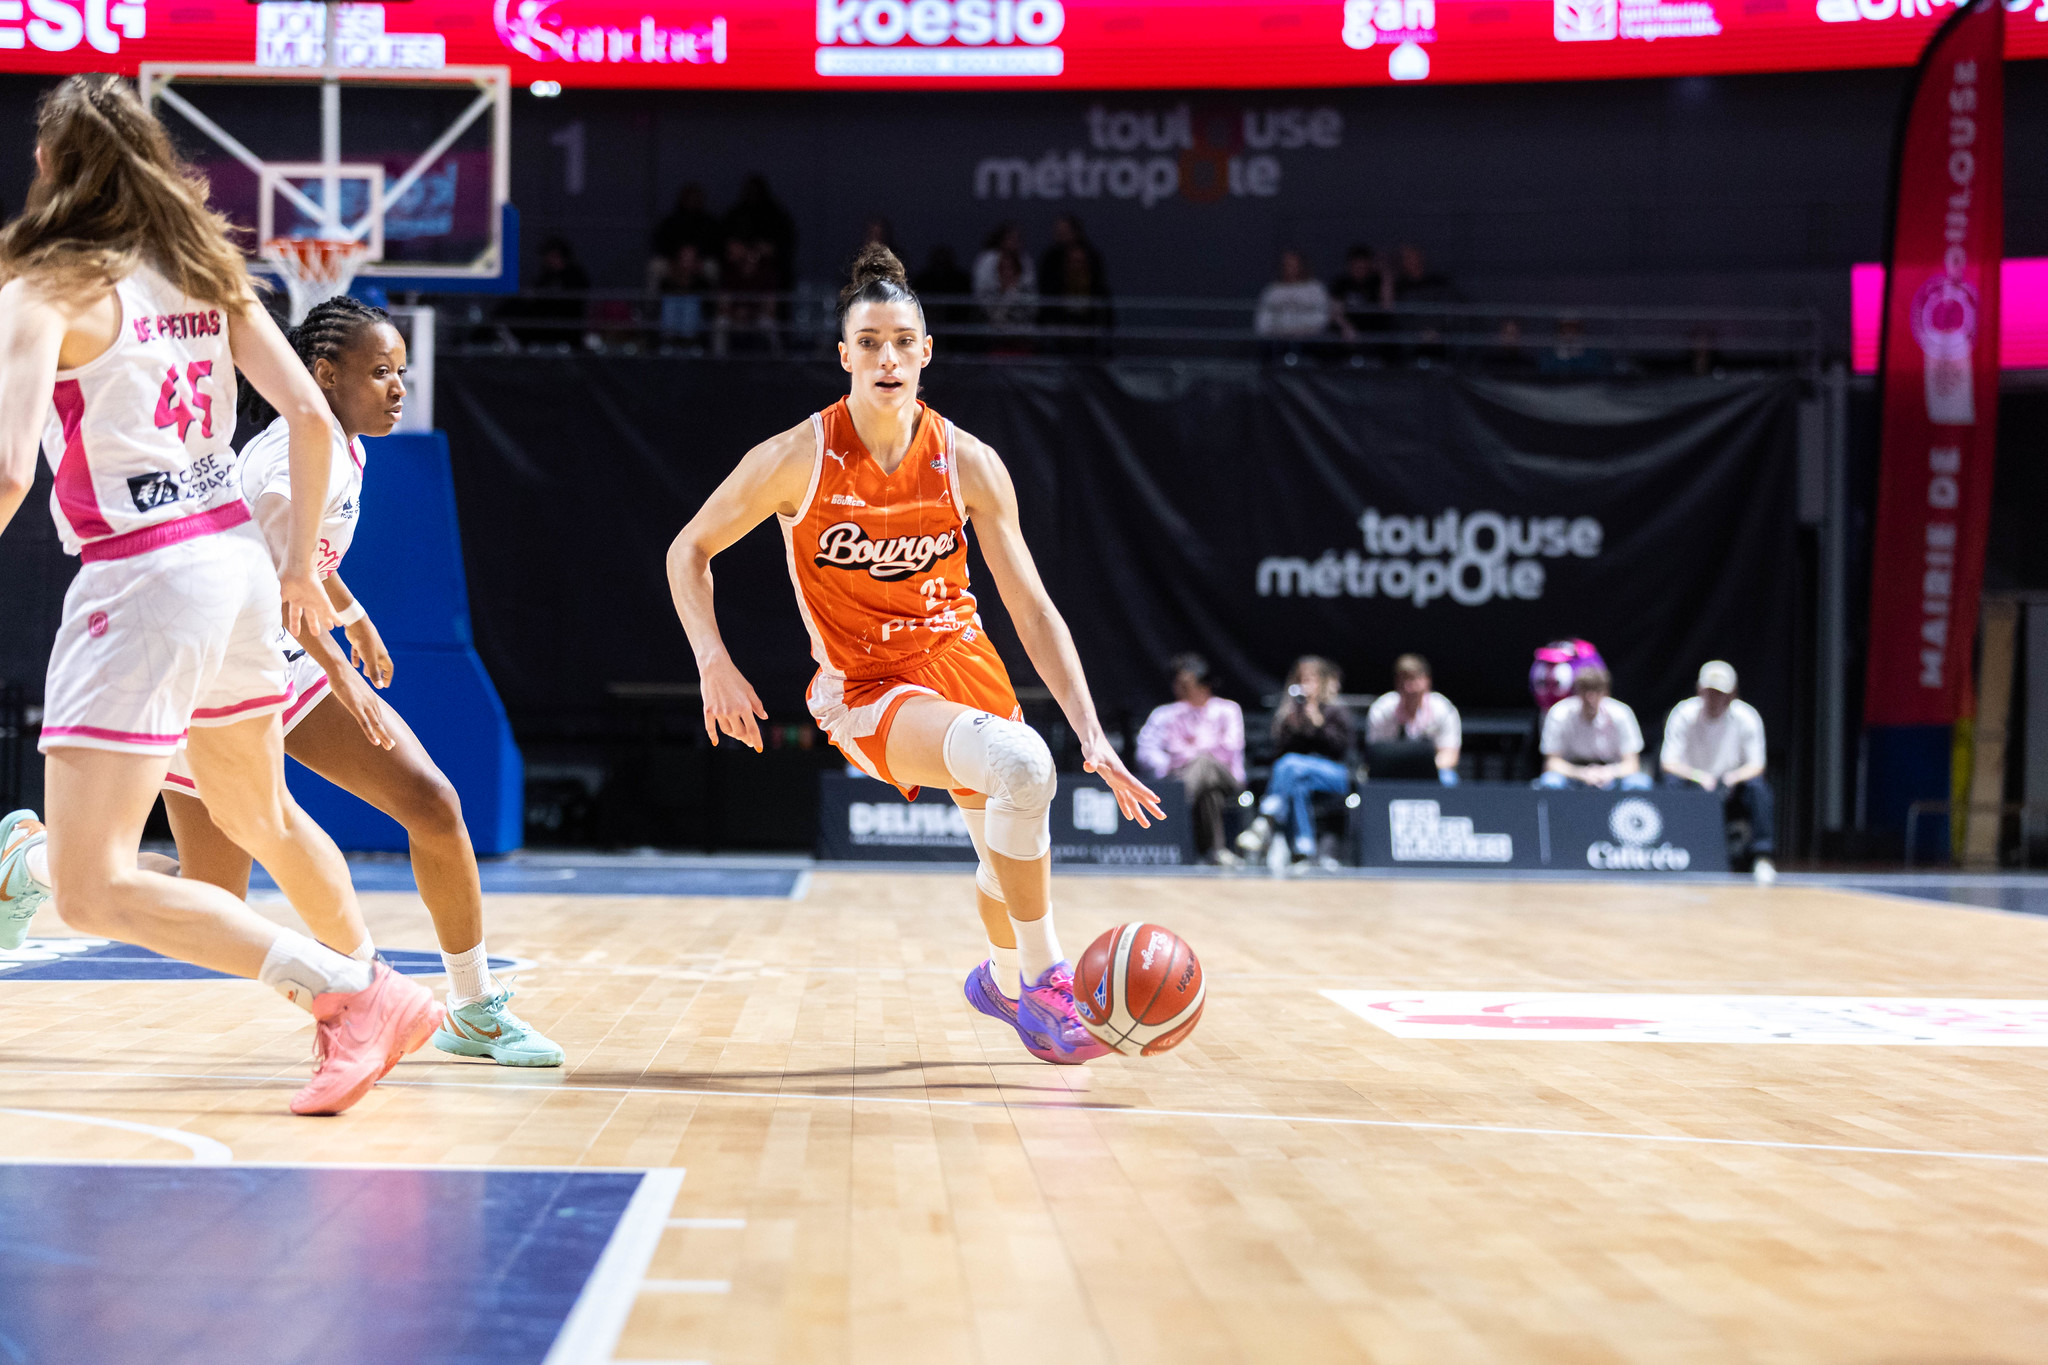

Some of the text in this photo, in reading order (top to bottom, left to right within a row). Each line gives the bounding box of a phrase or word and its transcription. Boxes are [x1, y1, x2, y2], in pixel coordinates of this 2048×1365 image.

[154, 360, 213, 443] 45
[1927, 446, 1961, 509] DE
[814, 521, 957, 580] Bourges
[1360, 507, 1603, 557] toulouse
[920, 576, 948, 612] 21
[1918, 521, 1957, 688] MAIRIE
